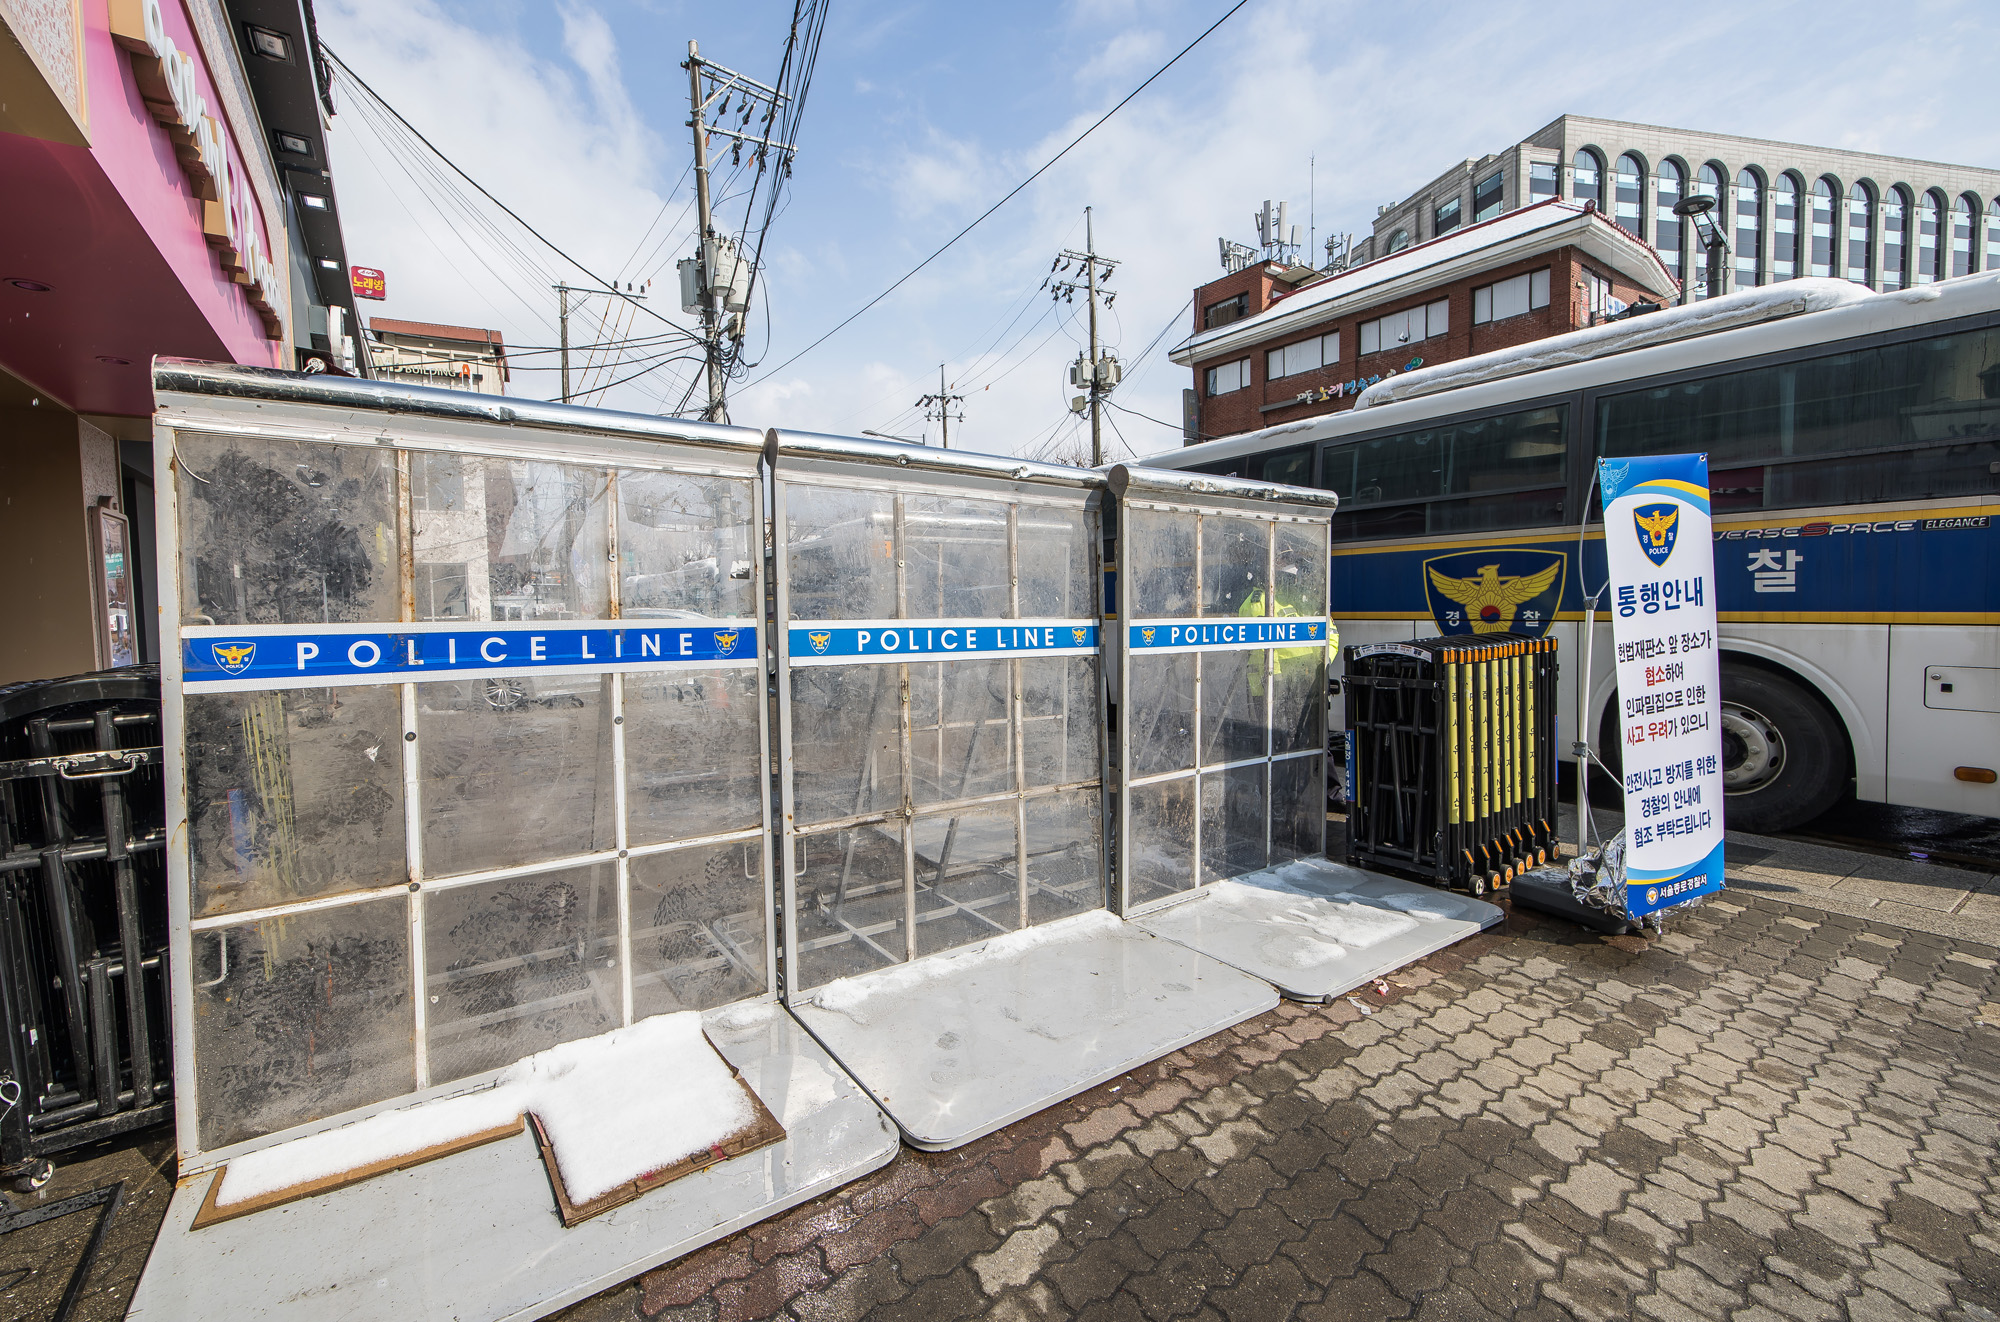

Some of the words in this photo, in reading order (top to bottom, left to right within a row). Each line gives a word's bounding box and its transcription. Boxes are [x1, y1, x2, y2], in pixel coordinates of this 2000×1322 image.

[353, 276, 384, 291] 노래방
[405, 366, 456, 378] BUILDING
[1925, 517, 1987, 529] ELEGANCE
[1649, 547, 1668, 555] POLICE
[1746, 548, 1803, 593] 찰
[1617, 576, 1703, 617] 통행안내
[1445, 611, 1459, 627] 경
[1522, 610, 1541, 627] 찰
[857, 628, 978, 652] POLICE
[997, 628, 1054, 649] LINE
[1170, 625, 1246, 644] POLICE
[1258, 624, 1296, 640] LINE
[1618, 637, 1665, 663] 헌법재판소
[1668, 634, 1678, 655] 앞
[1681, 629, 1711, 653] 장소가
[297, 635, 547, 670] POLICE
[582, 633, 692, 659] LINE
[1645, 661, 1683, 687] 협소하여
[1626, 690, 1683, 718] 인파밀집으로
[1686, 685, 1705, 706] 인한
[1627, 725, 1645, 746] 사고
[1648, 718, 1678, 742] 우려가
[1680, 711, 1709, 737] 있으니
[1626, 768, 1662, 794] 안전사고
[1665, 759, 1694, 785] 방지를
[1696, 755, 1716, 777] 위한
[1641, 793, 1670, 818] 경찰의
[1673, 785, 1701, 810] 안내에
[1634, 827, 1653, 848] 협조
[1656, 809, 1711, 842] 부탁드립니다
[1660, 873, 1707, 898] 서울종로경찰서
